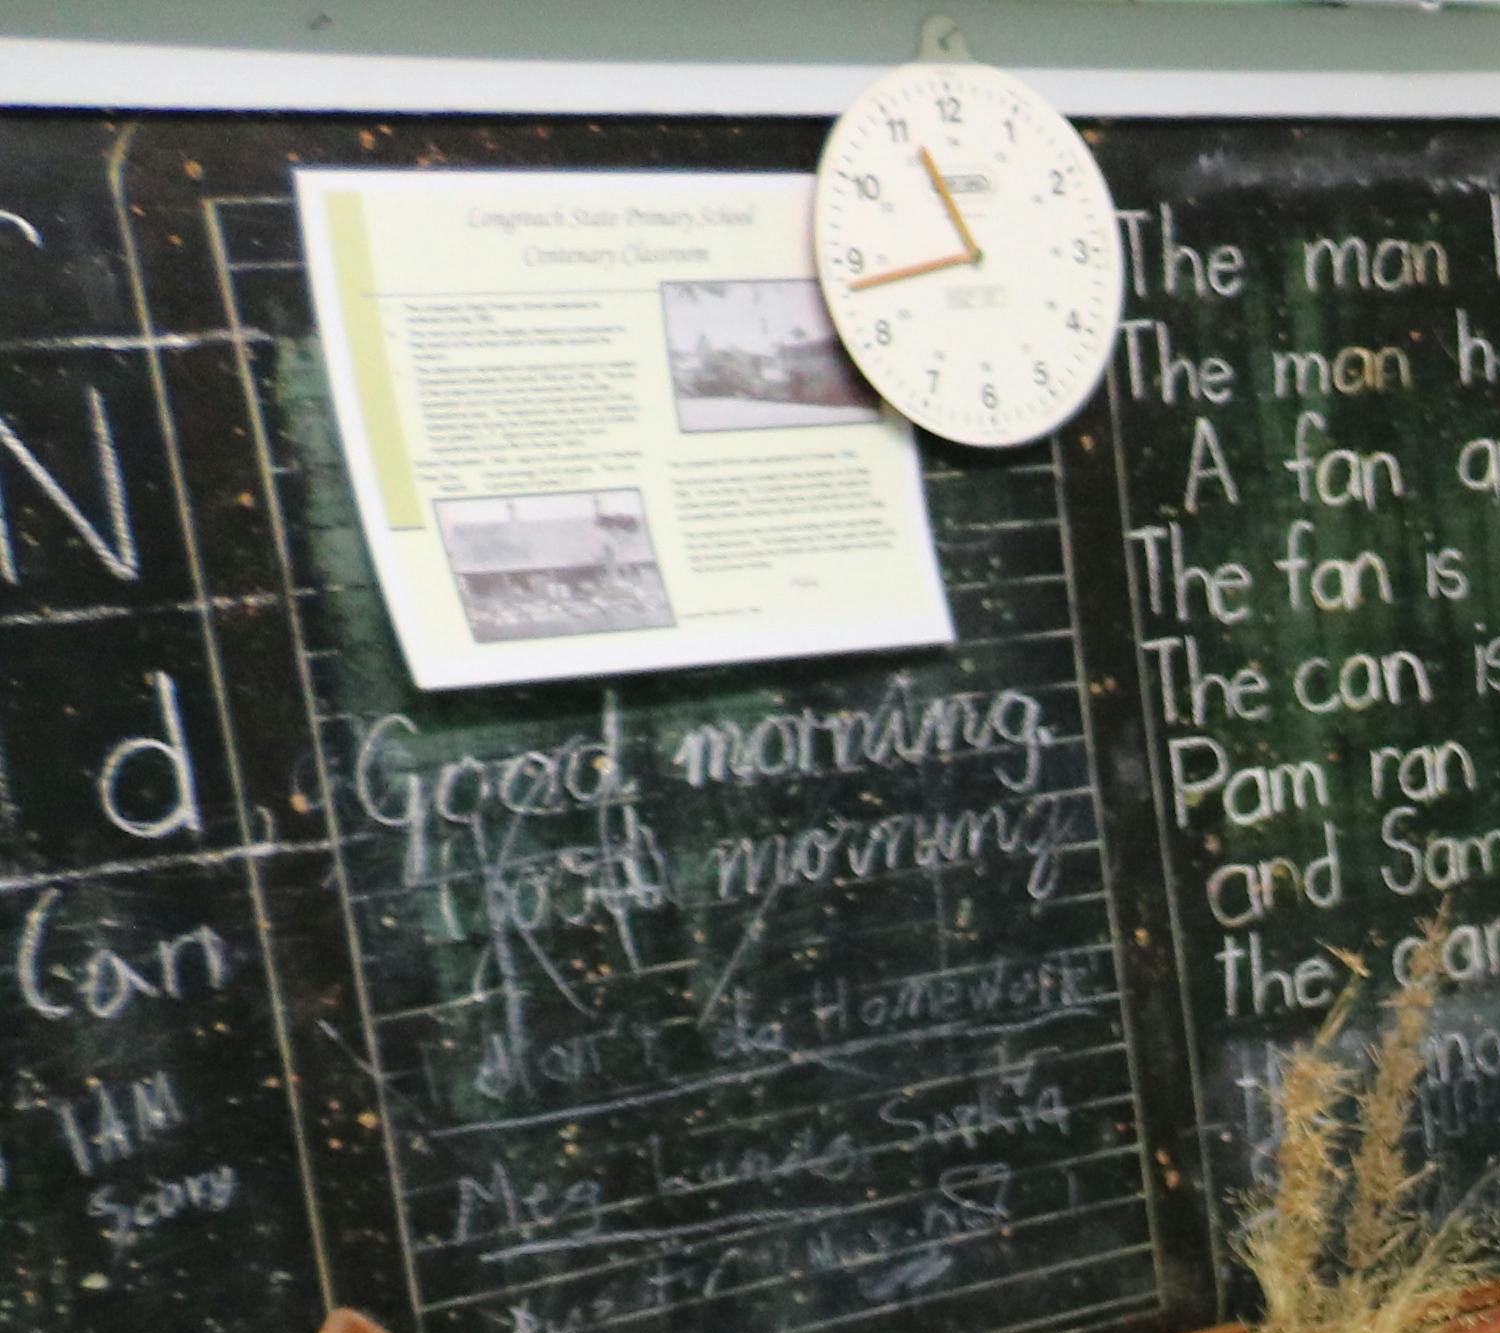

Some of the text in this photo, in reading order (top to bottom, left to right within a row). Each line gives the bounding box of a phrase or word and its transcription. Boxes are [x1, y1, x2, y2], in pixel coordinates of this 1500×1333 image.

[936, 97, 962, 123] 12
[886, 118, 909, 143] 11
[1004, 119, 1016, 142] 1
[853, 174, 881, 200] 10
[1048, 170, 1067, 195] 2
[845, 247, 865, 274] 9
[1071, 238, 1090, 264] 3
[1113, 202, 1245, 298] The
[1304, 232, 1451, 292] man
[875, 319, 892, 346] 8
[1065, 310, 1083, 333] 4
[1031, 360, 1049, 386] 5
[1116, 318, 1236, 405] The
[1274, 343, 1411, 397] man
[926, 369, 940, 394] 7
[982, 383, 998, 409] 6
[1183, 415, 1240, 514] A
[1284, 410, 1403, 511] fan
[1124, 521, 1254, 624] The
[1275, 519, 1394, 612] fan
[1424, 531, 1470, 600] is
[1142, 634, 1273, 729] The
[1294, 647, 1432, 716] can
[1168, 735, 1330, 830] Pam
[1368, 737, 1478, 802] ran
[1205, 820, 1343, 930] and
[1213, 930, 1339, 1019] the
